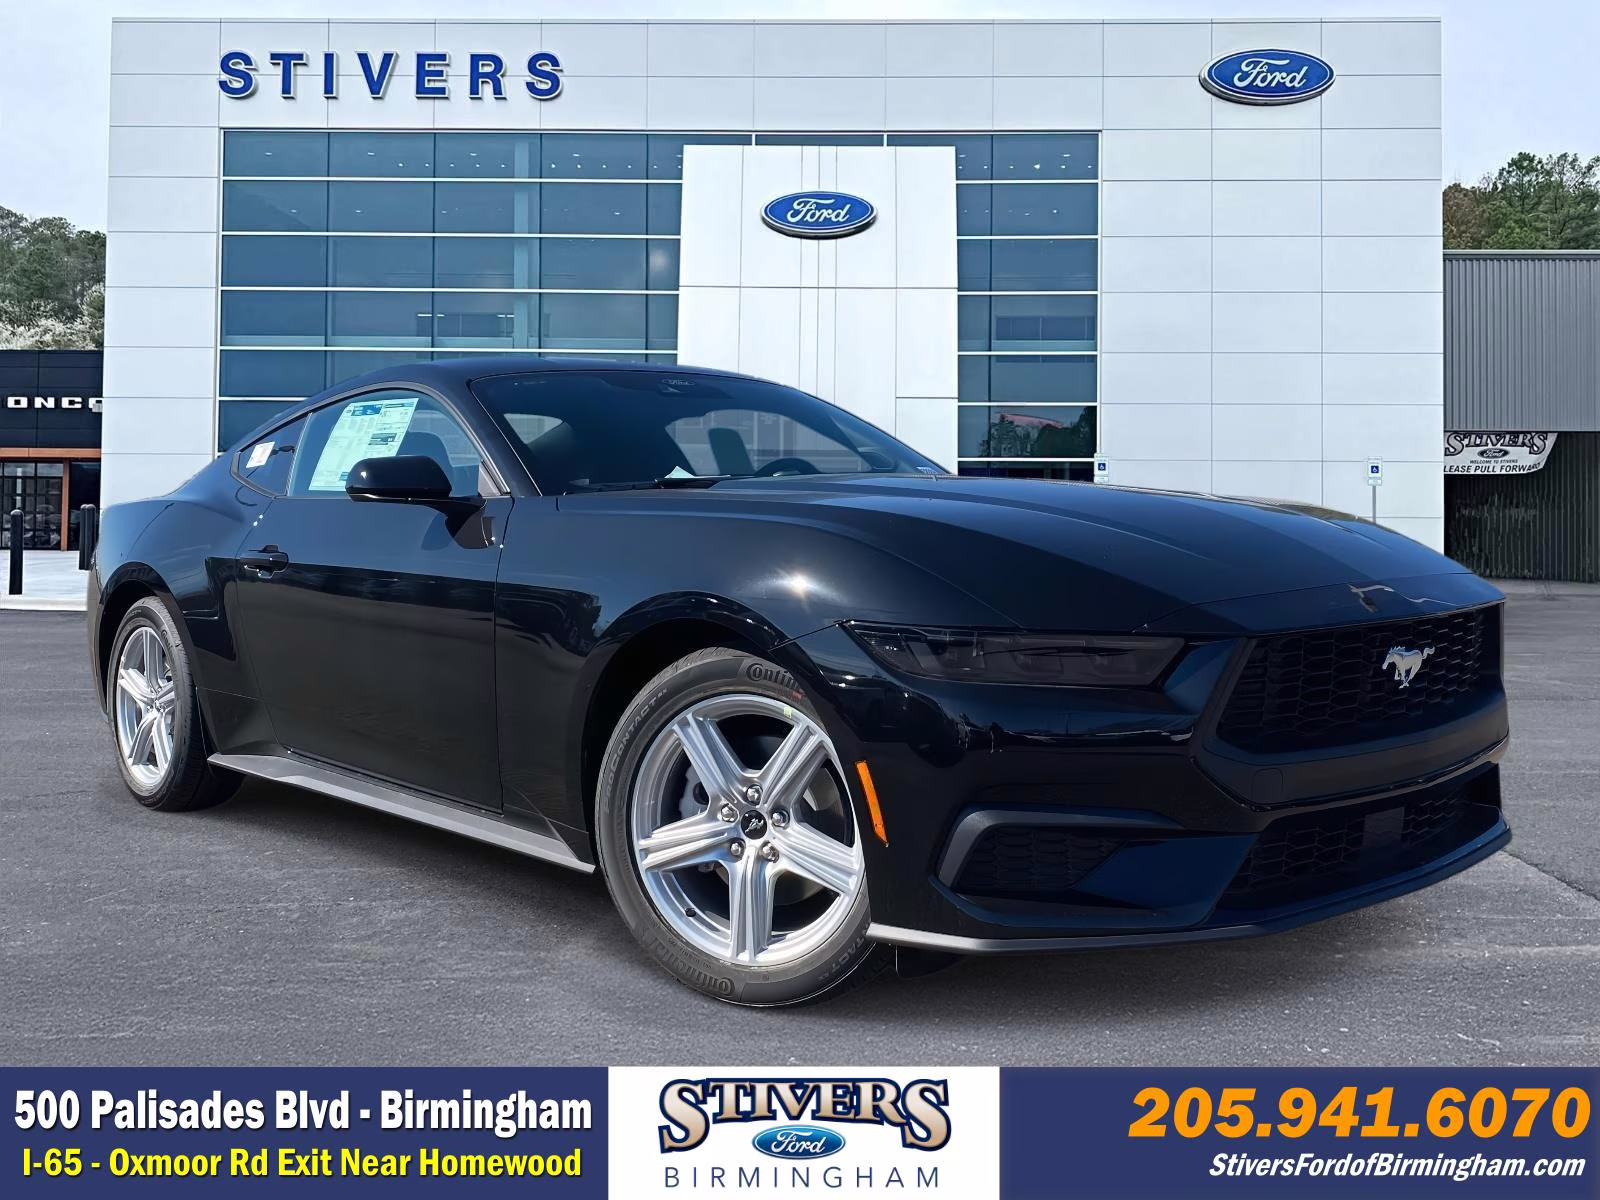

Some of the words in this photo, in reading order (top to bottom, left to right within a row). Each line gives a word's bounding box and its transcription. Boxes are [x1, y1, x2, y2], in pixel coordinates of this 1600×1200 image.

[219, 50, 563, 99] STIVERS
[1233, 58, 1308, 88] Ford
[787, 198, 851, 222] Ford
[1445, 432, 1548, 456] STIVERS
[1483, 449, 1505, 457] Ford
[1444, 465, 1472, 473] LEASE
[1474, 465, 1496, 473] PULL
